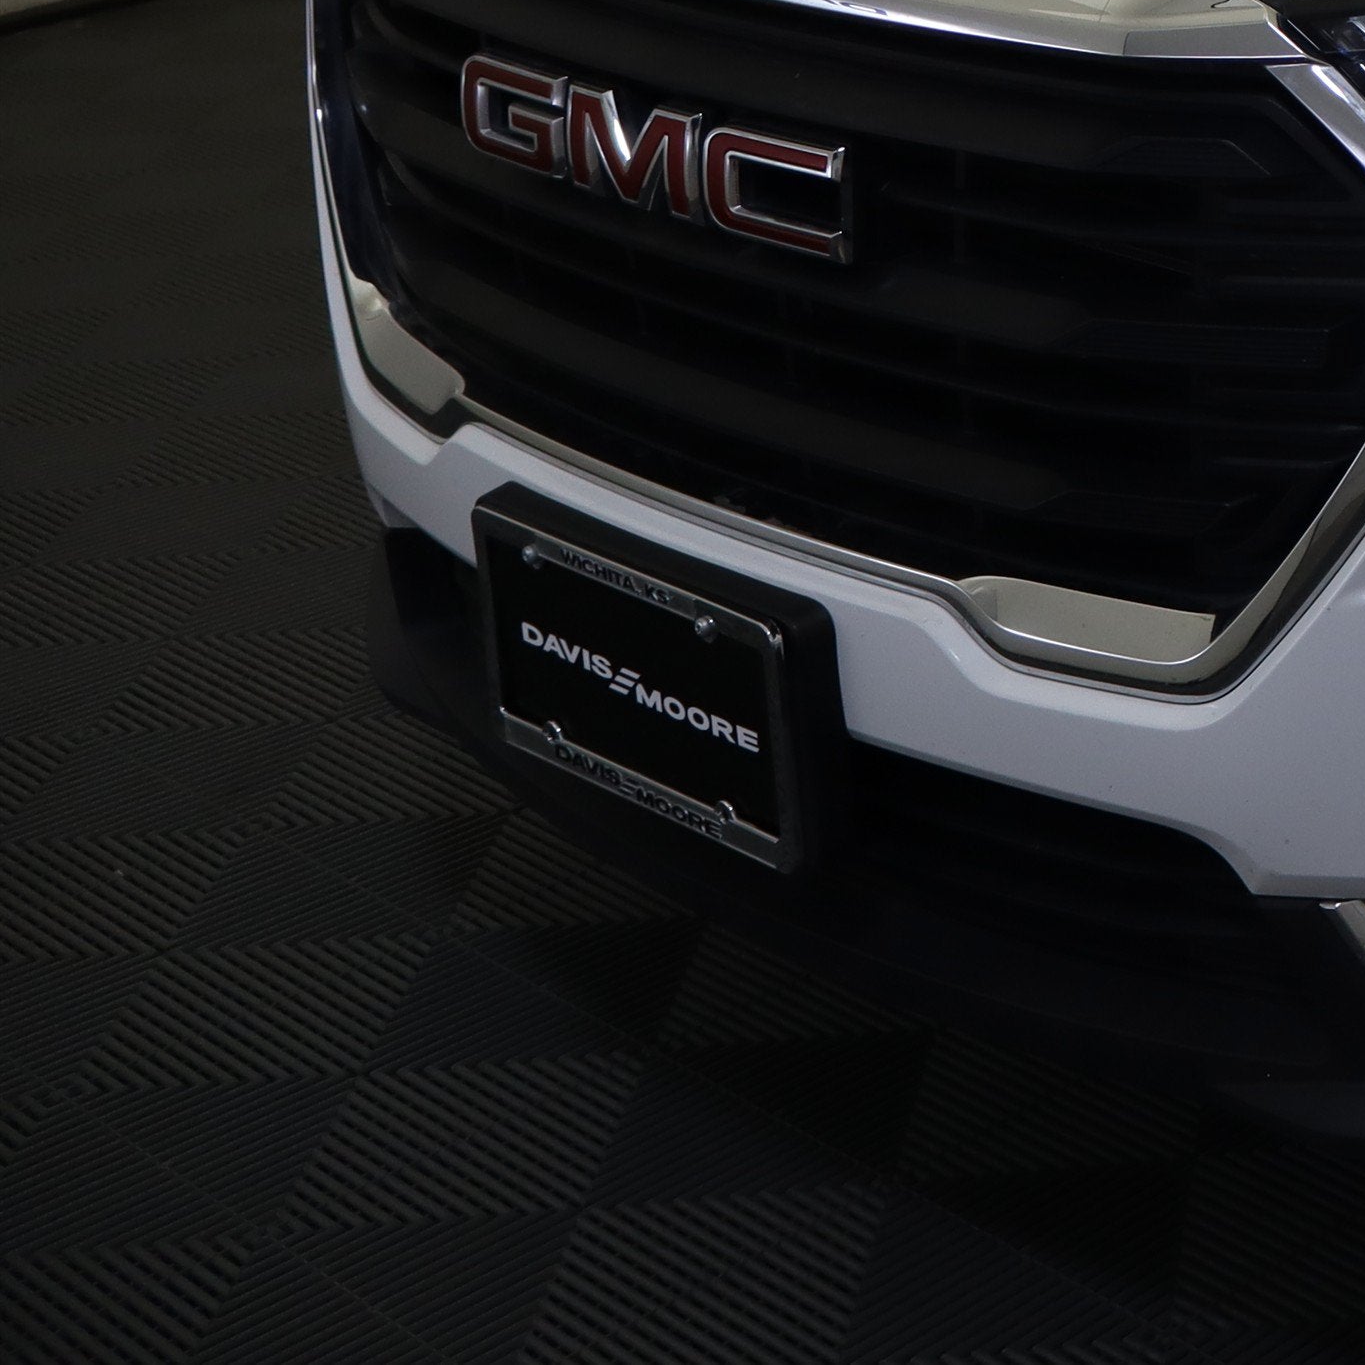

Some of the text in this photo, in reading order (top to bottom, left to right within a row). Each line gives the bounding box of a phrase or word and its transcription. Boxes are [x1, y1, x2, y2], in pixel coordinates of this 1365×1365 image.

[461, 54, 852, 264] GMC
[521, 621, 760, 754] DAVIS MOORE
[555, 744, 723, 841] DAVIS MOORE
